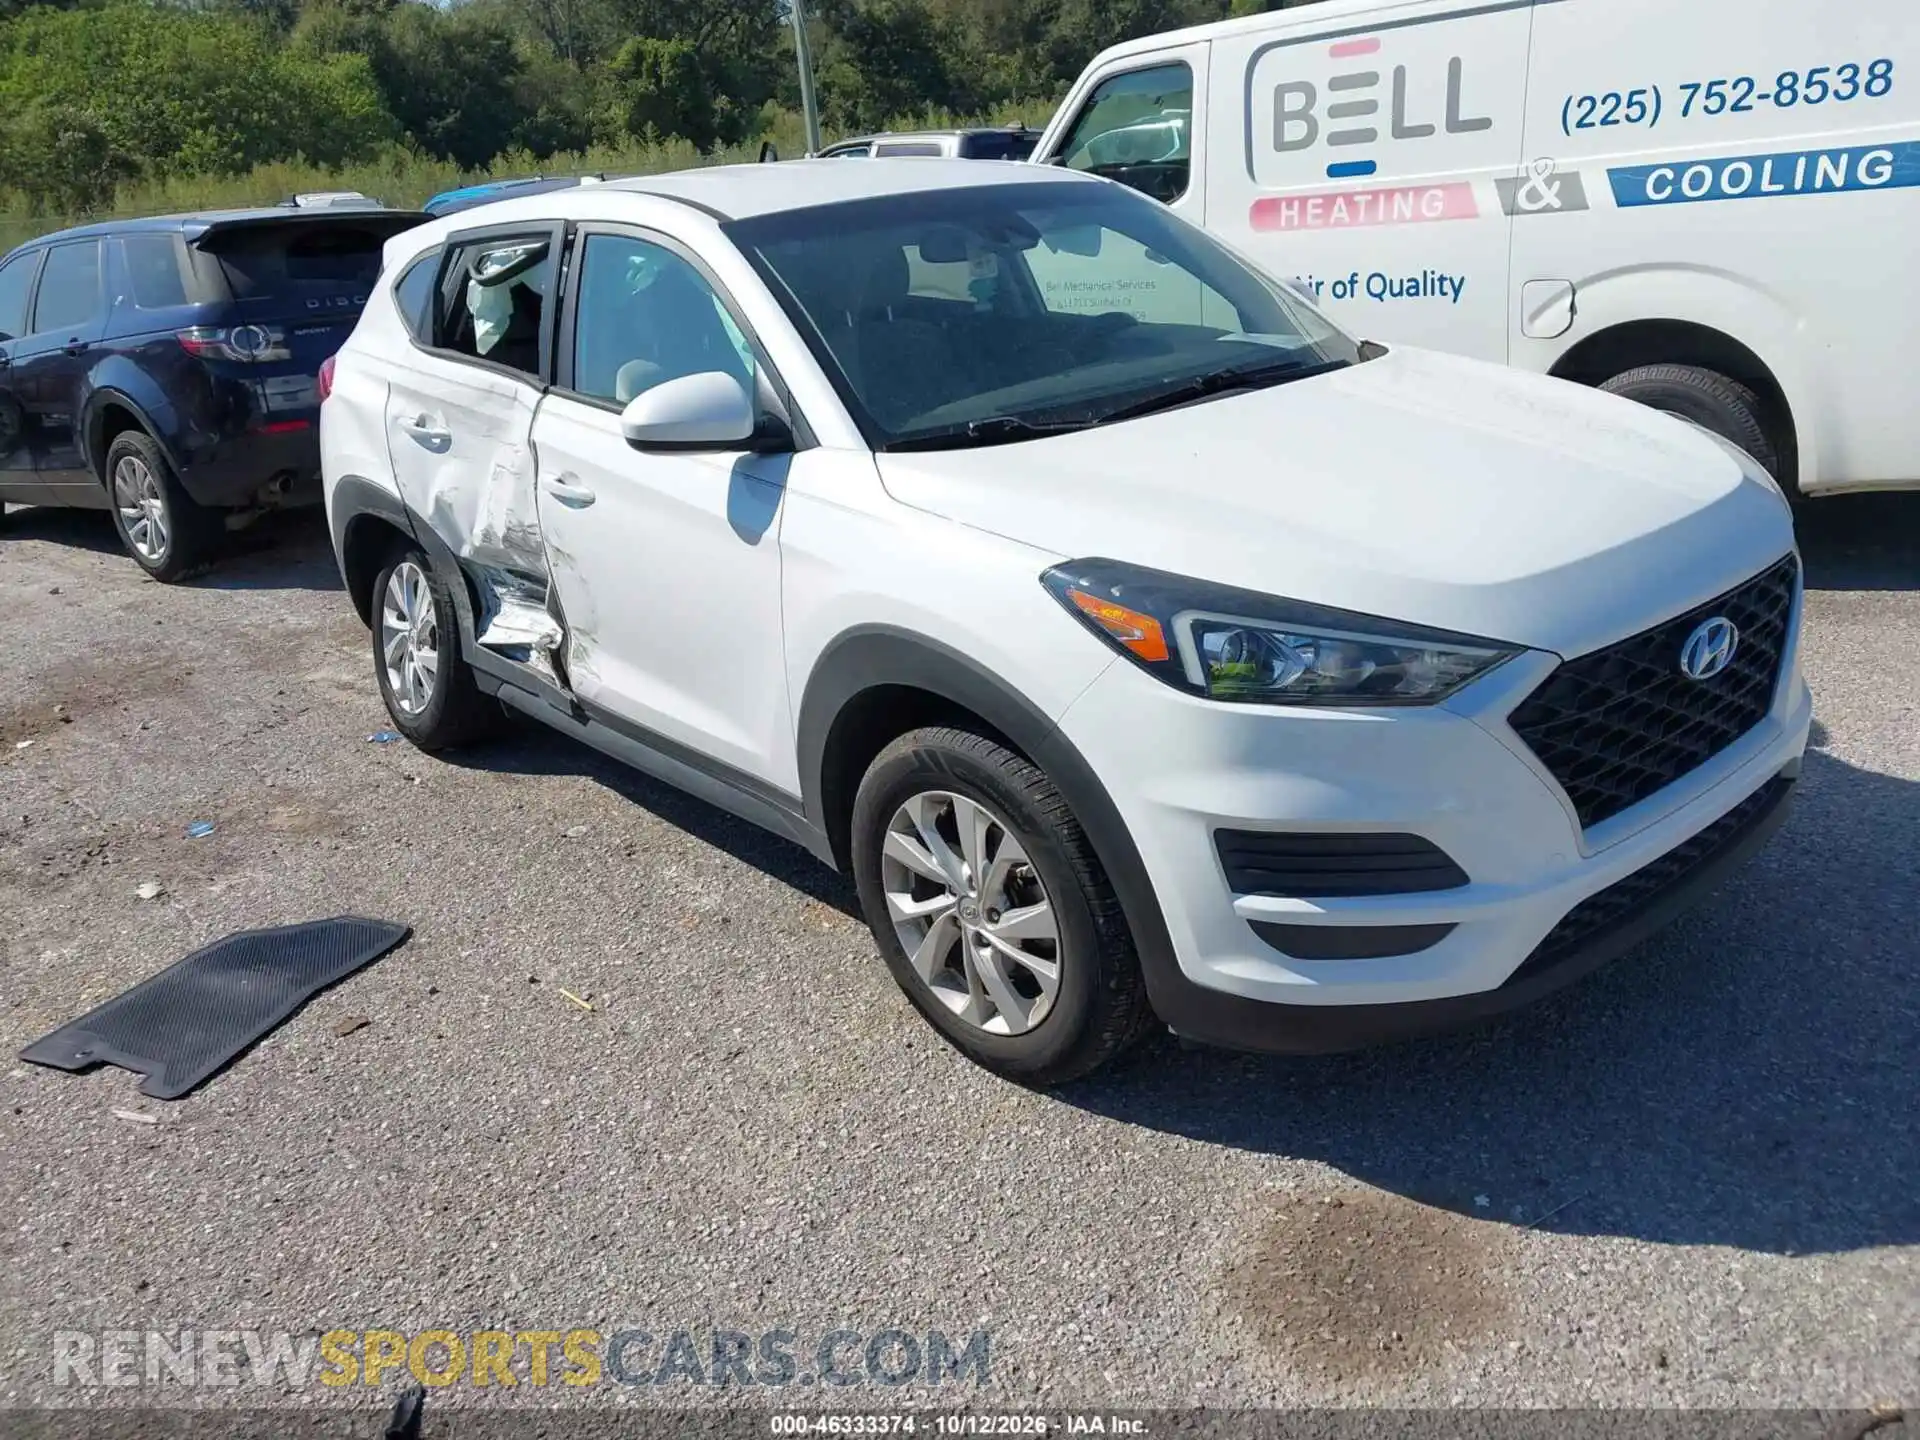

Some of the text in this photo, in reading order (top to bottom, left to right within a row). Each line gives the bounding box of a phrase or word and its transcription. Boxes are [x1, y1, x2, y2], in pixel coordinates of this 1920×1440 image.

[1273, 56, 1493, 153] BELL
[1561, 58, 1894, 137] (225) 752-8538
[1279, 149, 1895, 228] HEATING & COOLING
[1116, 279, 1157, 291] Services
[1331, 272, 1359, 299] of
[1366, 270, 1466, 304] Quality
